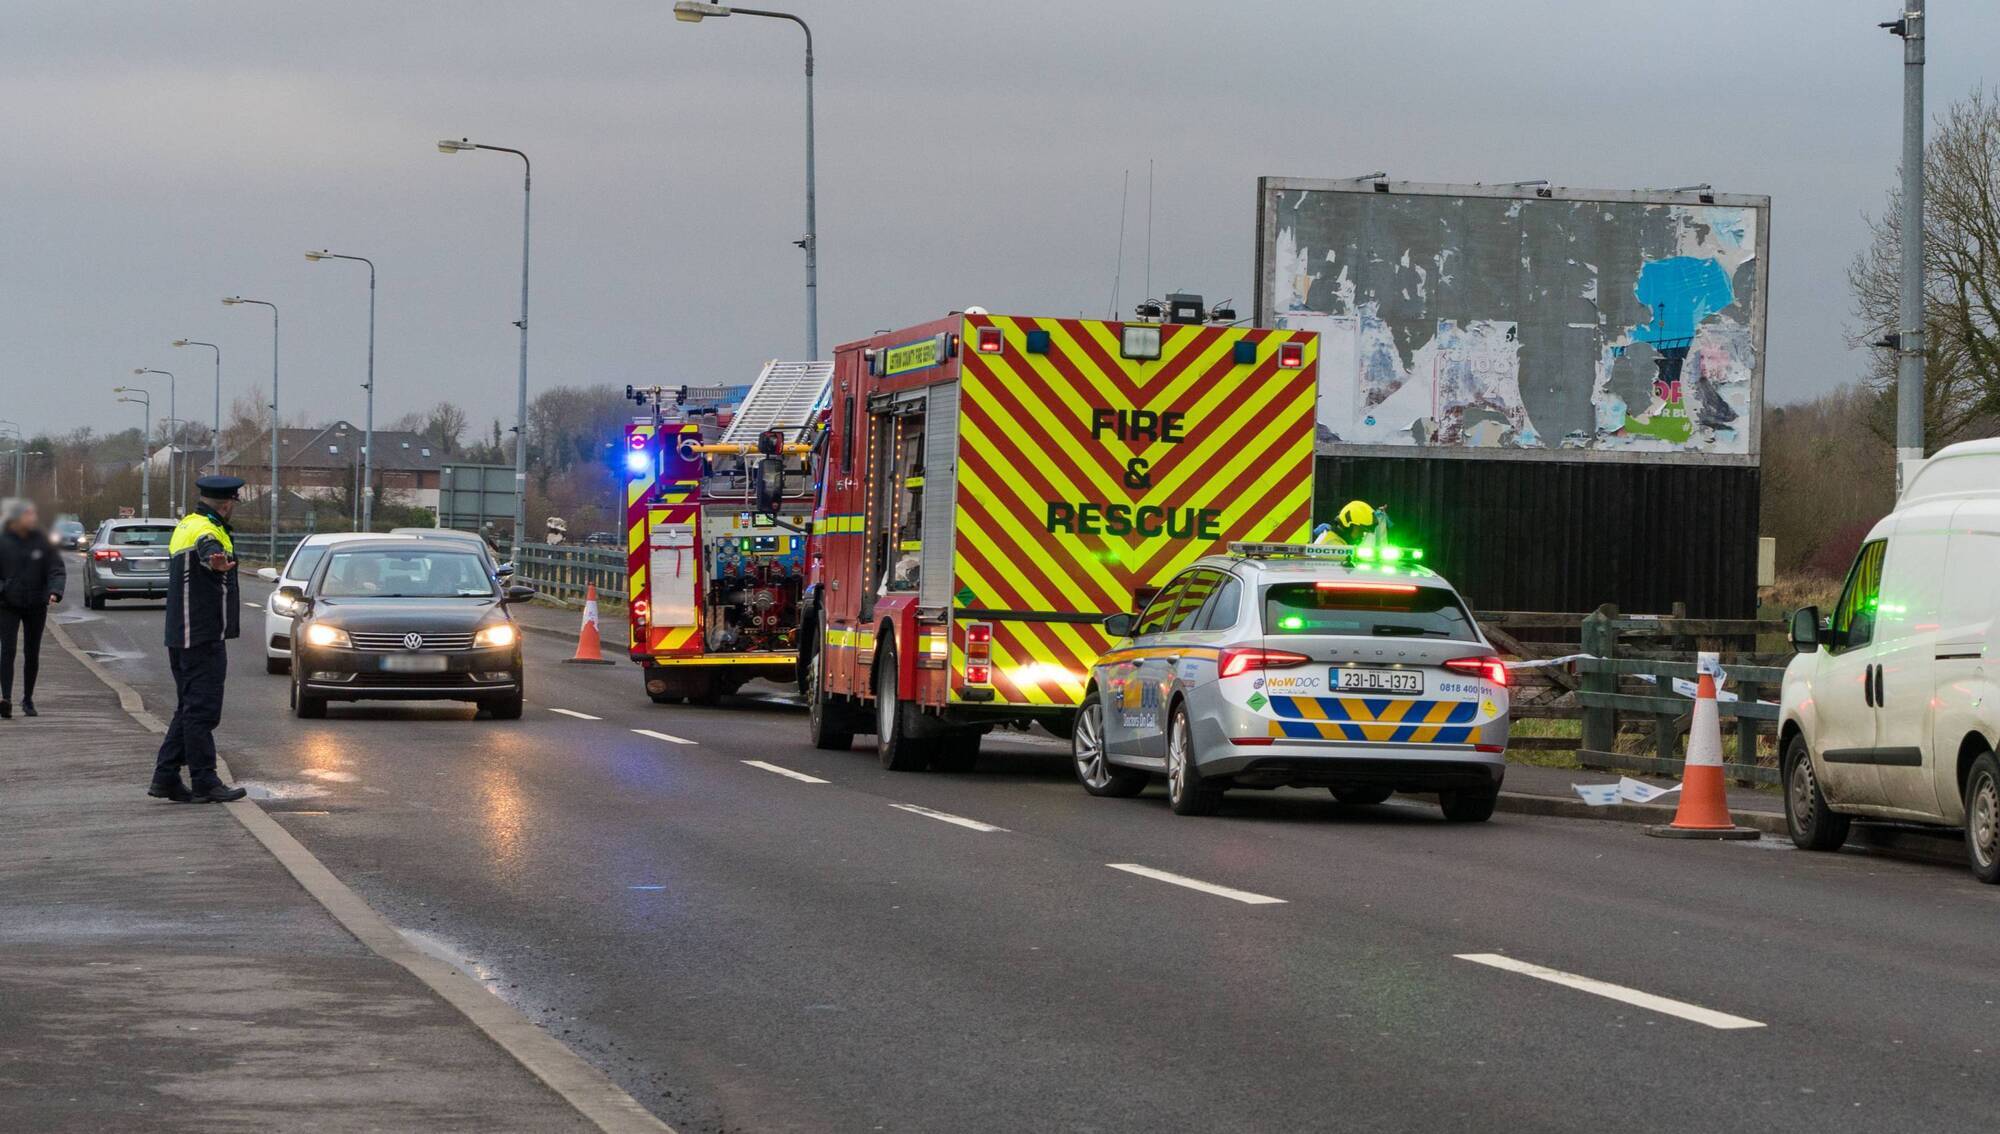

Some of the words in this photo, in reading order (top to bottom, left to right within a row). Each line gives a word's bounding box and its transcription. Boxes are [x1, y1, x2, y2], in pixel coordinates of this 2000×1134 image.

[1091, 408, 1185, 444] FIRE
[1123, 457, 1152, 490] &
[1046, 501, 1222, 541] RESCUE
[1307, 547, 1354, 556] DOCTOR
[1344, 673, 1417, 689] 231-DL-1373
[1440, 682, 1461, 693] 0818
[1463, 684, 1478, 694] 400
[1480, 686, 1493, 696] 911
